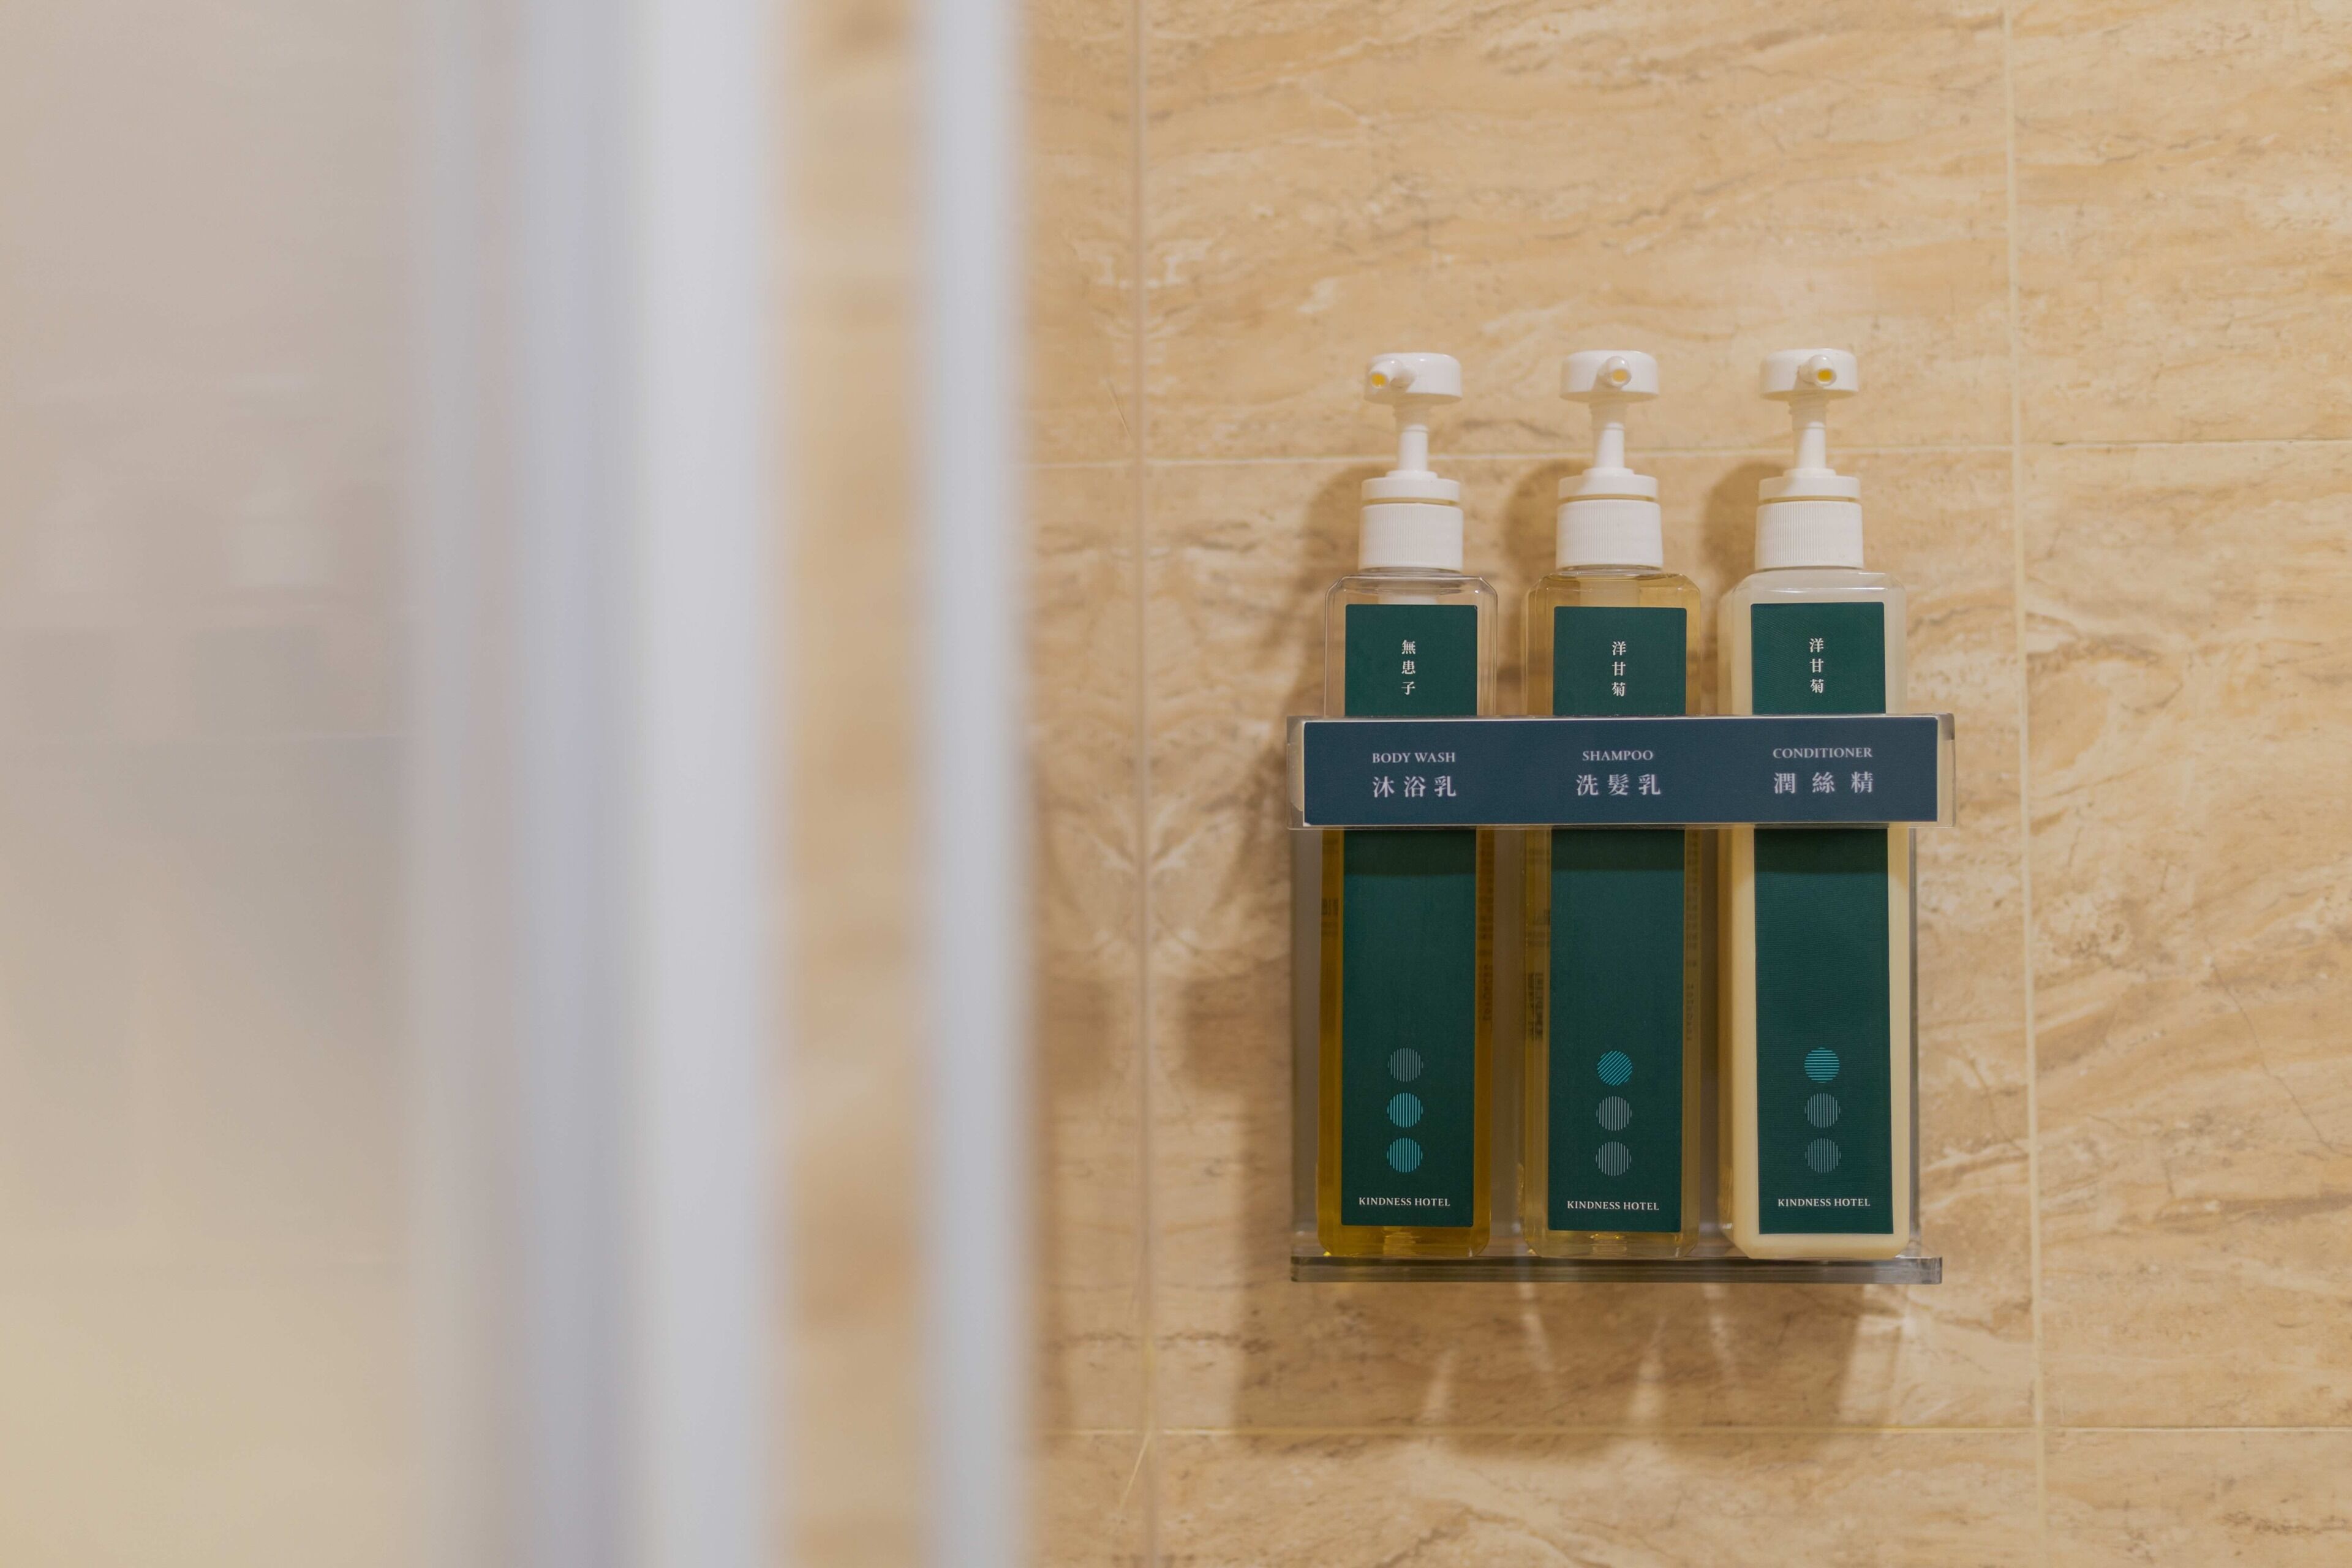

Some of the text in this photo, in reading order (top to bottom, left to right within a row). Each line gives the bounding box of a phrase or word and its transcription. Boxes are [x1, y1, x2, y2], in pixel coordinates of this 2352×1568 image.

[1401, 640, 1416, 695] 無患子
[1611, 641, 1627, 697] 洋甘菊
[1809, 638, 1825, 694] 洋甘菊
[1372, 752, 1456, 764] BODY WASH
[1582, 750, 1654, 761] SHAMPOO
[1773, 747, 1873, 759] CONDITIONER
[1372, 775, 1457, 798] 沐浴乳
[1576, 774, 1661, 796] 洗髮乳
[1773, 771, 1874, 794] 潤絲精
[1359, 1197, 1450, 1207] KINDNESS HOTEL
[1567, 1200, 1659, 1211] KINDNESS HOTEL
[1777, 1198, 1871, 1207] KINDNESS HOTEL
